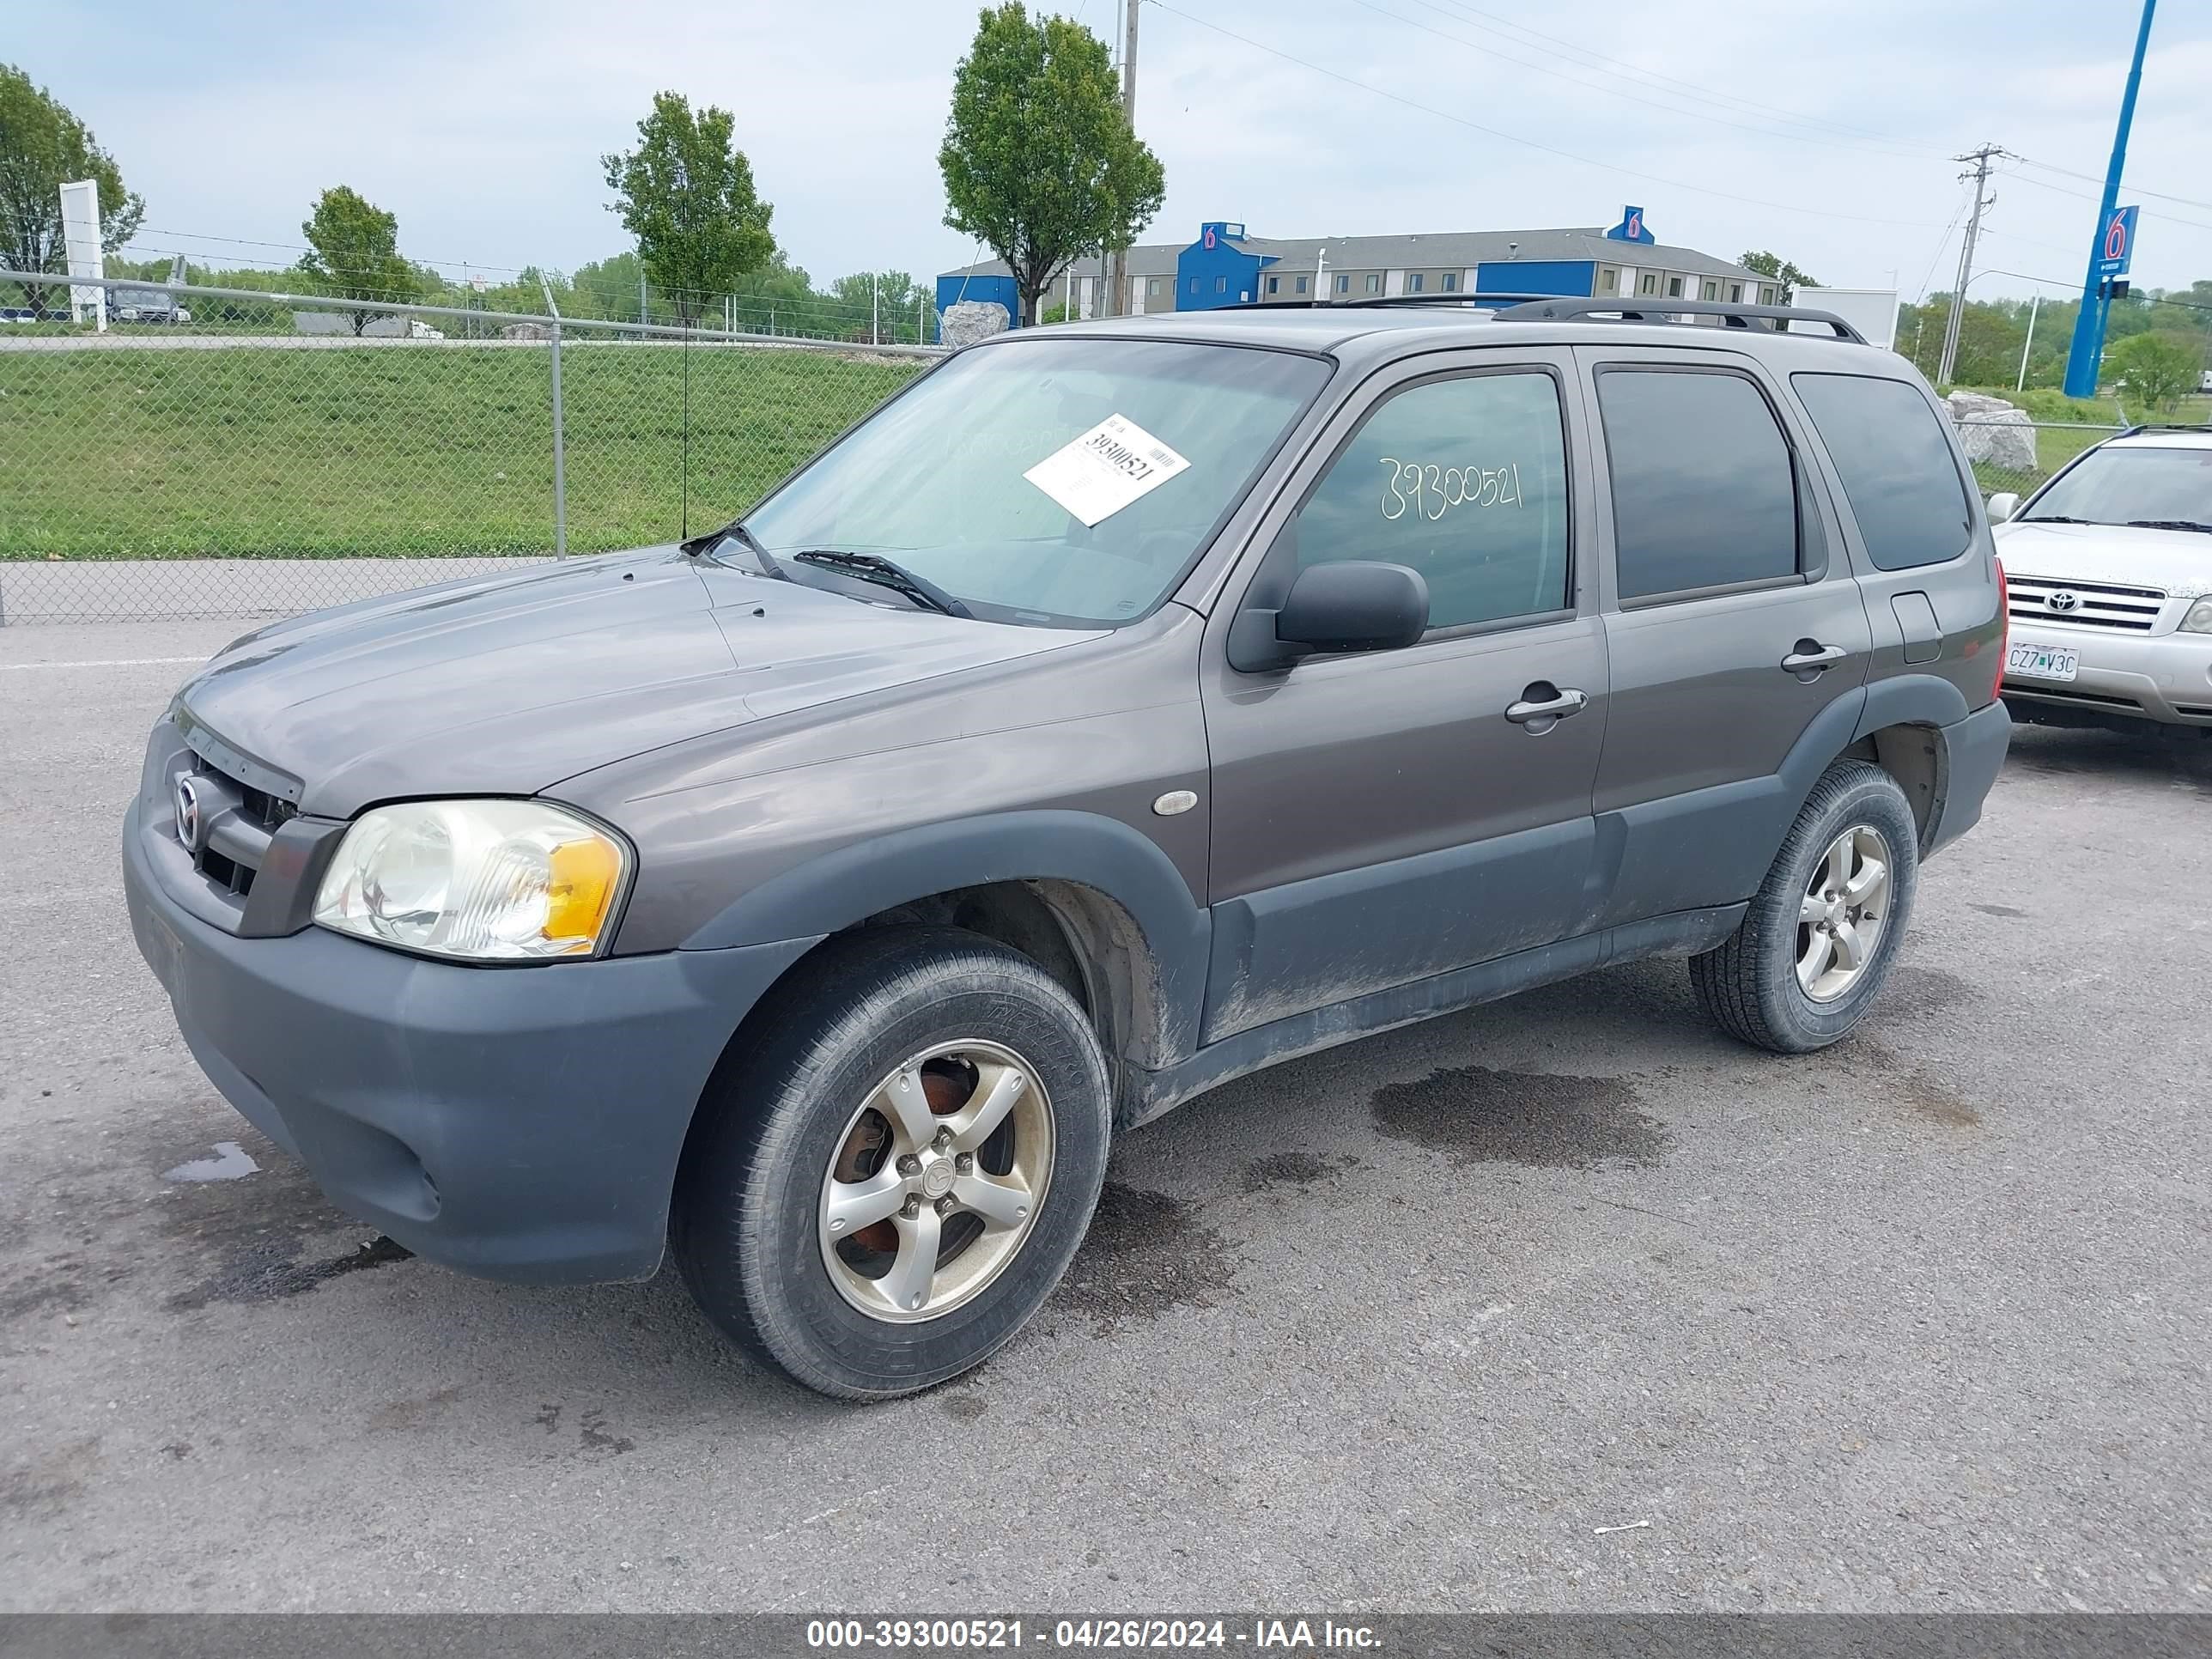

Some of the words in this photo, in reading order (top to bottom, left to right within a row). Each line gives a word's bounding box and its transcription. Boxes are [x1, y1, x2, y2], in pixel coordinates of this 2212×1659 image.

[1205, 226, 1215, 248] 6
[1628, 212, 1640, 239] 6
[2104, 209, 2127, 259] 6
[1086, 434, 1154, 481] 39300521
[1379, 458, 1522, 520] 39300521
[2009, 649, 2039, 669] CZ7
[2047, 653, 2075, 673] V3C
